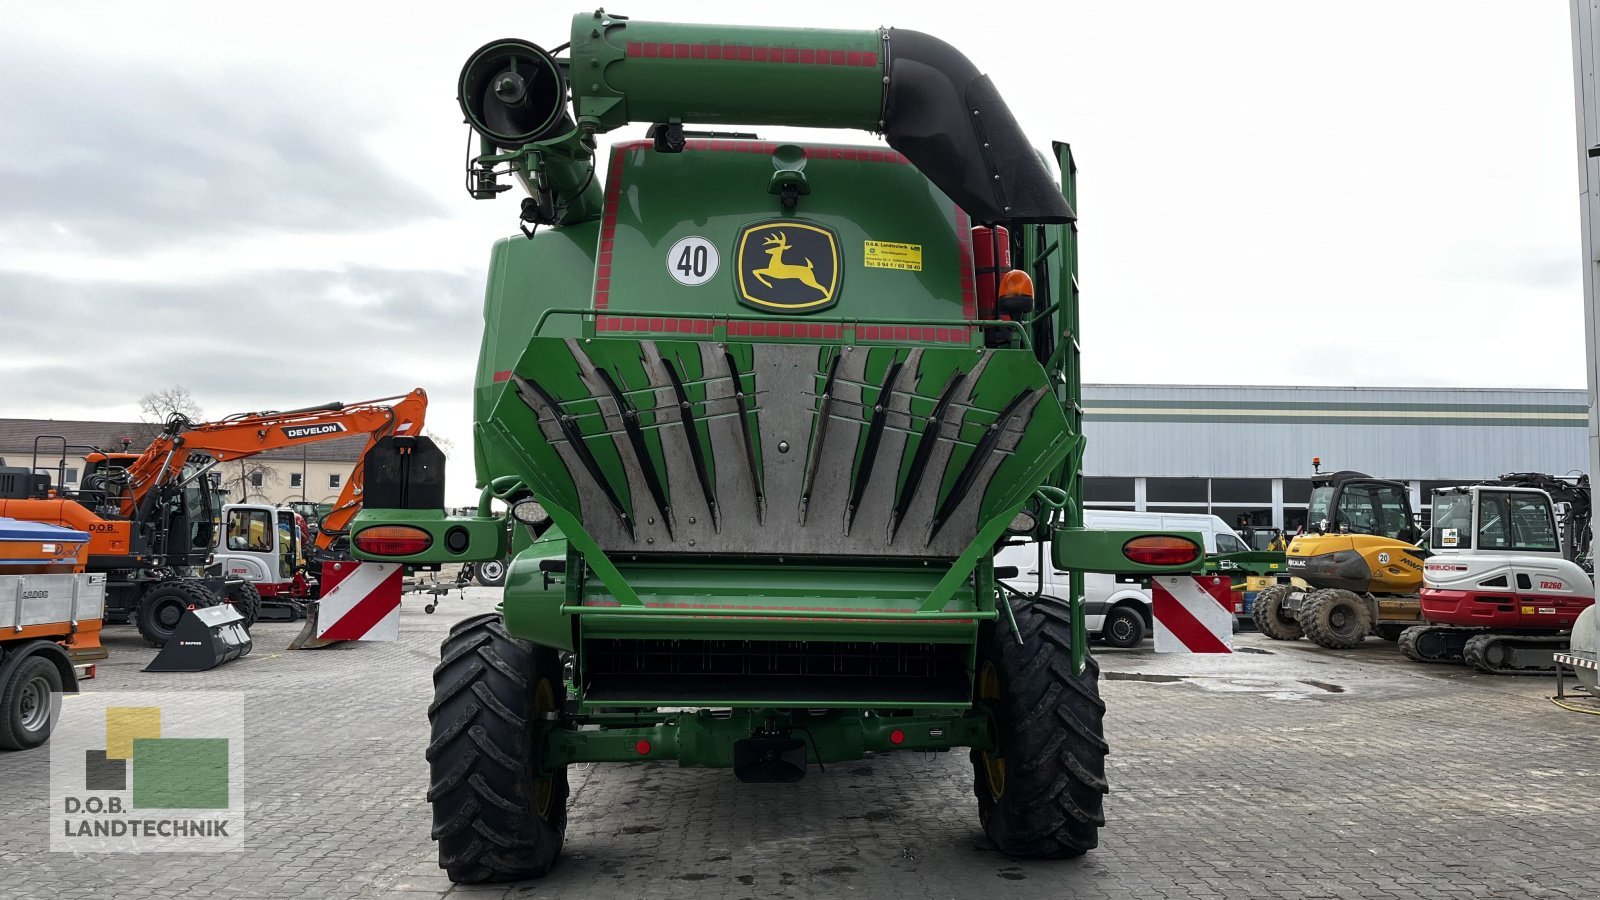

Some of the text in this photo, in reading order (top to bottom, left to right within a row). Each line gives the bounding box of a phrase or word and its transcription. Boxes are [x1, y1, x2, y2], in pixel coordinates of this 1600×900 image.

[677, 245, 708, 278] 40
[288, 424, 337, 437] DEVELON
[1379, 554, 1388, 562] 20
[1540, 581, 1562, 590] TB260
